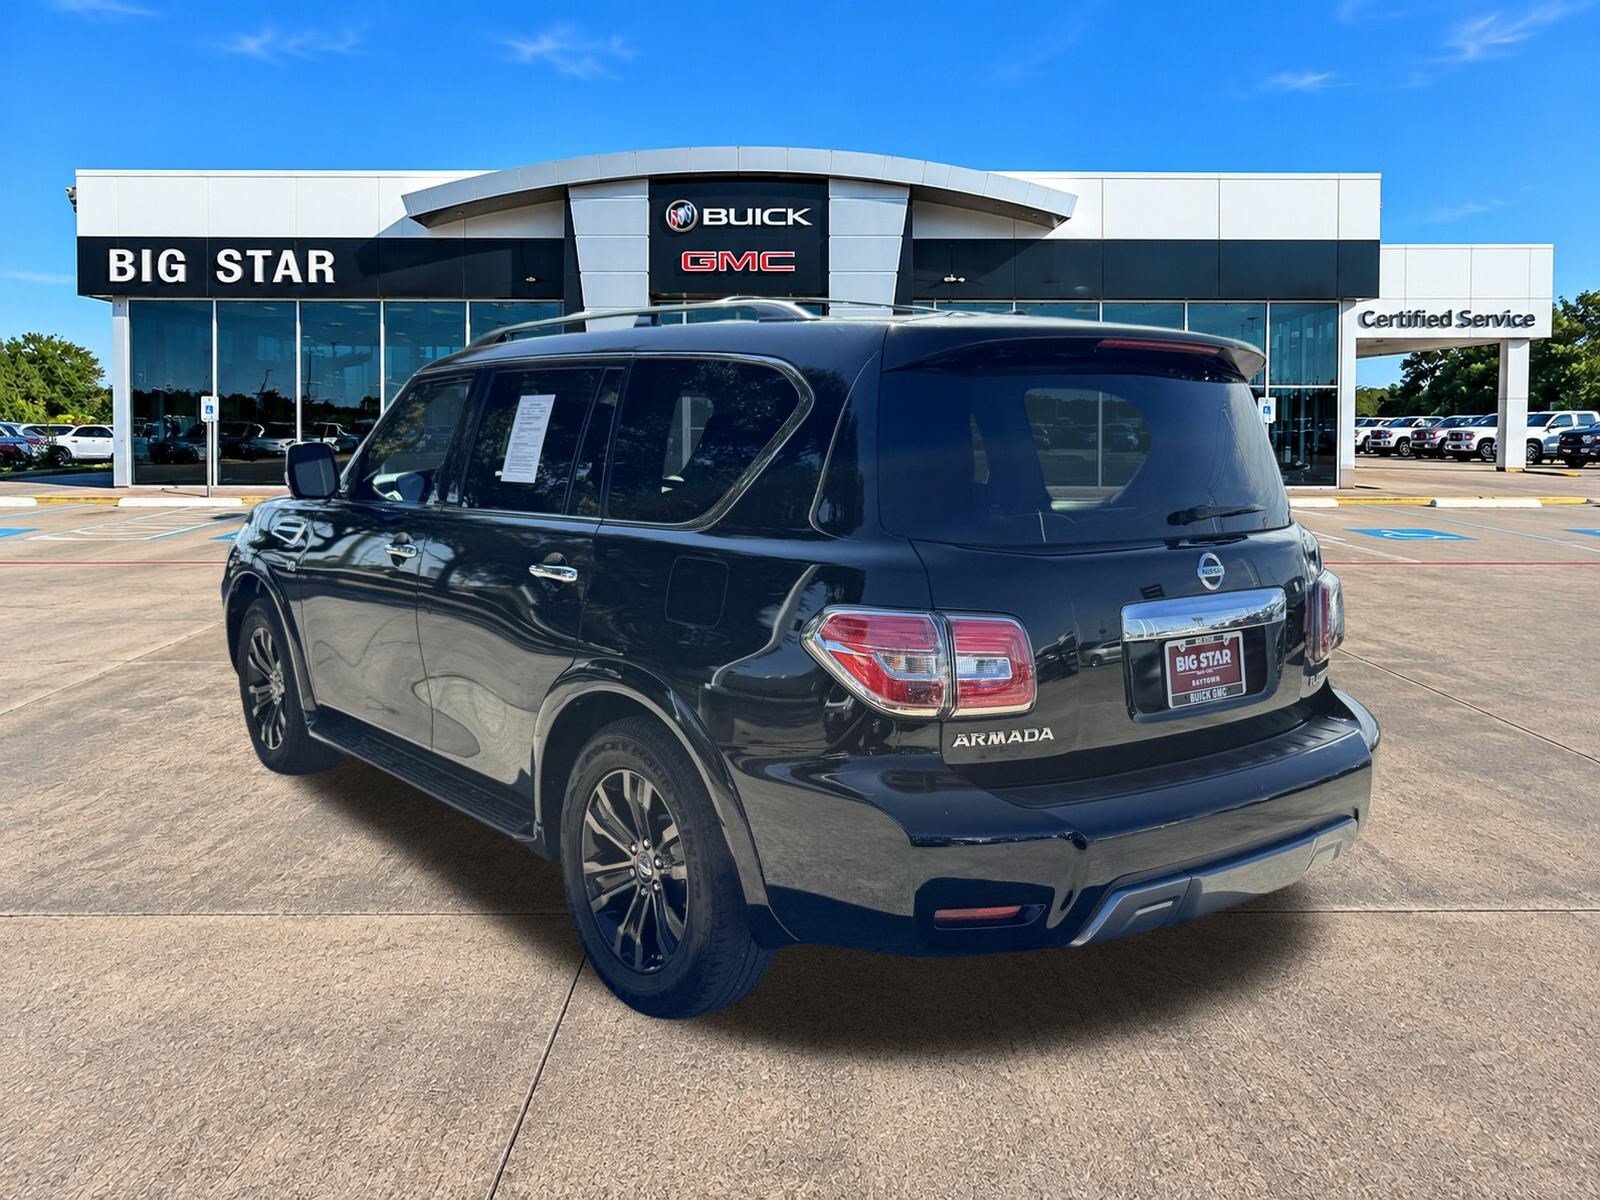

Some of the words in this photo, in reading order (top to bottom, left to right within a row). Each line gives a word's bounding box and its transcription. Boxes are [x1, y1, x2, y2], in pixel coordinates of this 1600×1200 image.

[702, 207, 813, 226] BUICK
[108, 248, 187, 283] BIG
[215, 248, 336, 284] STAR
[681, 251, 796, 272] GMC
[1359, 310, 1453, 329] Certified
[1455, 310, 1536, 329] Service
[1176, 655, 1198, 672] BIG
[1200, 649, 1231, 668] STAR
[1190, 691, 1212, 703] BUICK
[1212, 687, 1227, 699] GMC
[952, 727, 1055, 747] ARMADA
